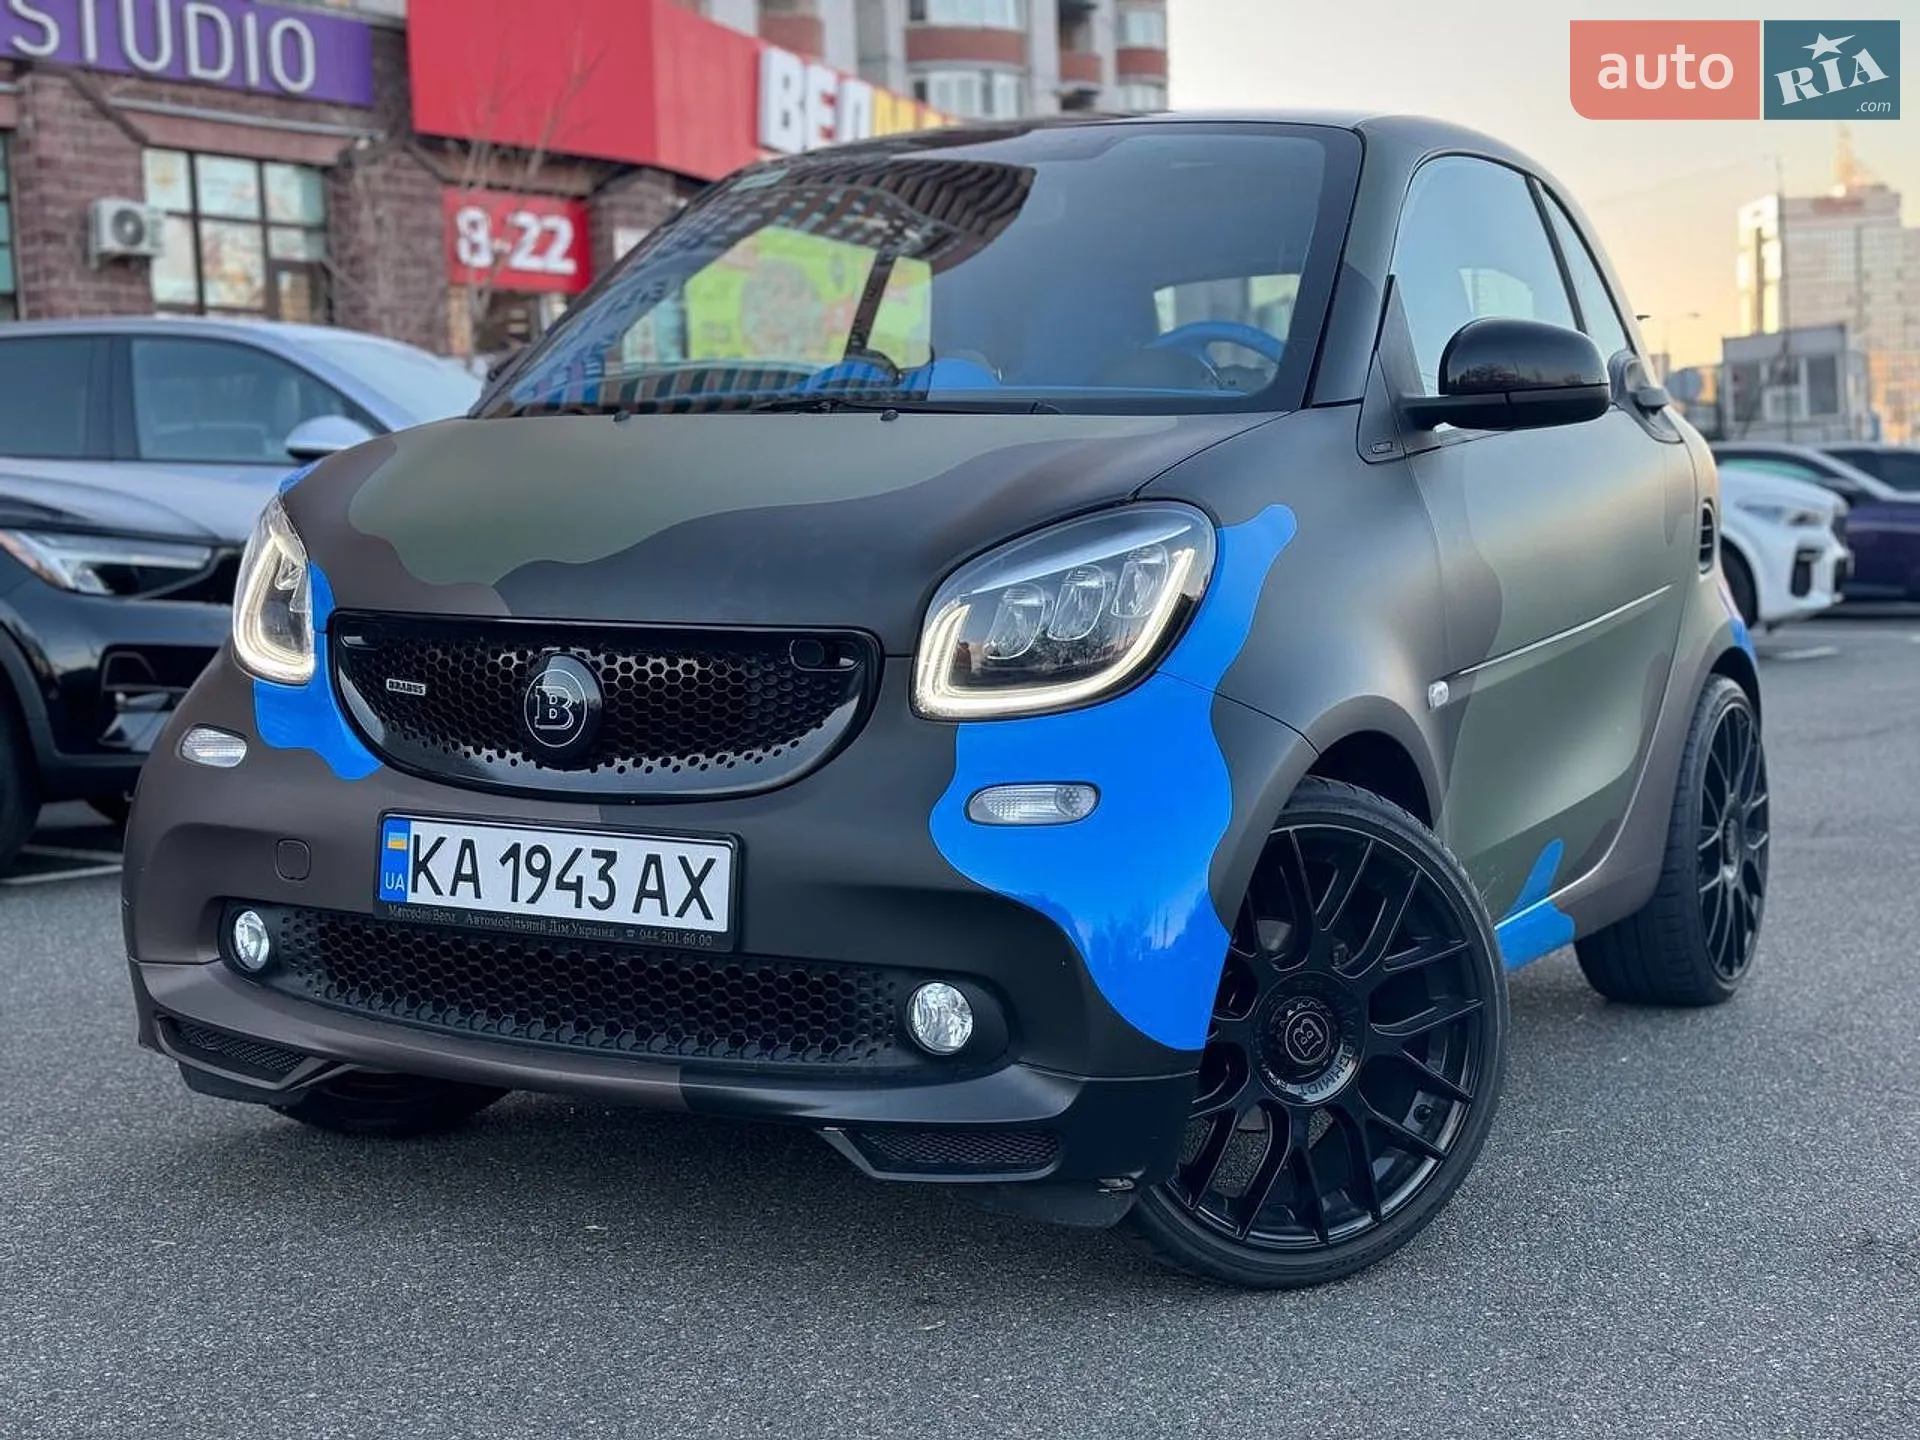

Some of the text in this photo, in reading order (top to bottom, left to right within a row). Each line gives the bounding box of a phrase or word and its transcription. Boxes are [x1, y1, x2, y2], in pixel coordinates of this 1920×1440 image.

[9, 0, 317, 93] STUDIO
[456, 205, 578, 275] 8-22
[385, 871, 406, 892] UA
[410, 833, 717, 921] KA 1943 AX
